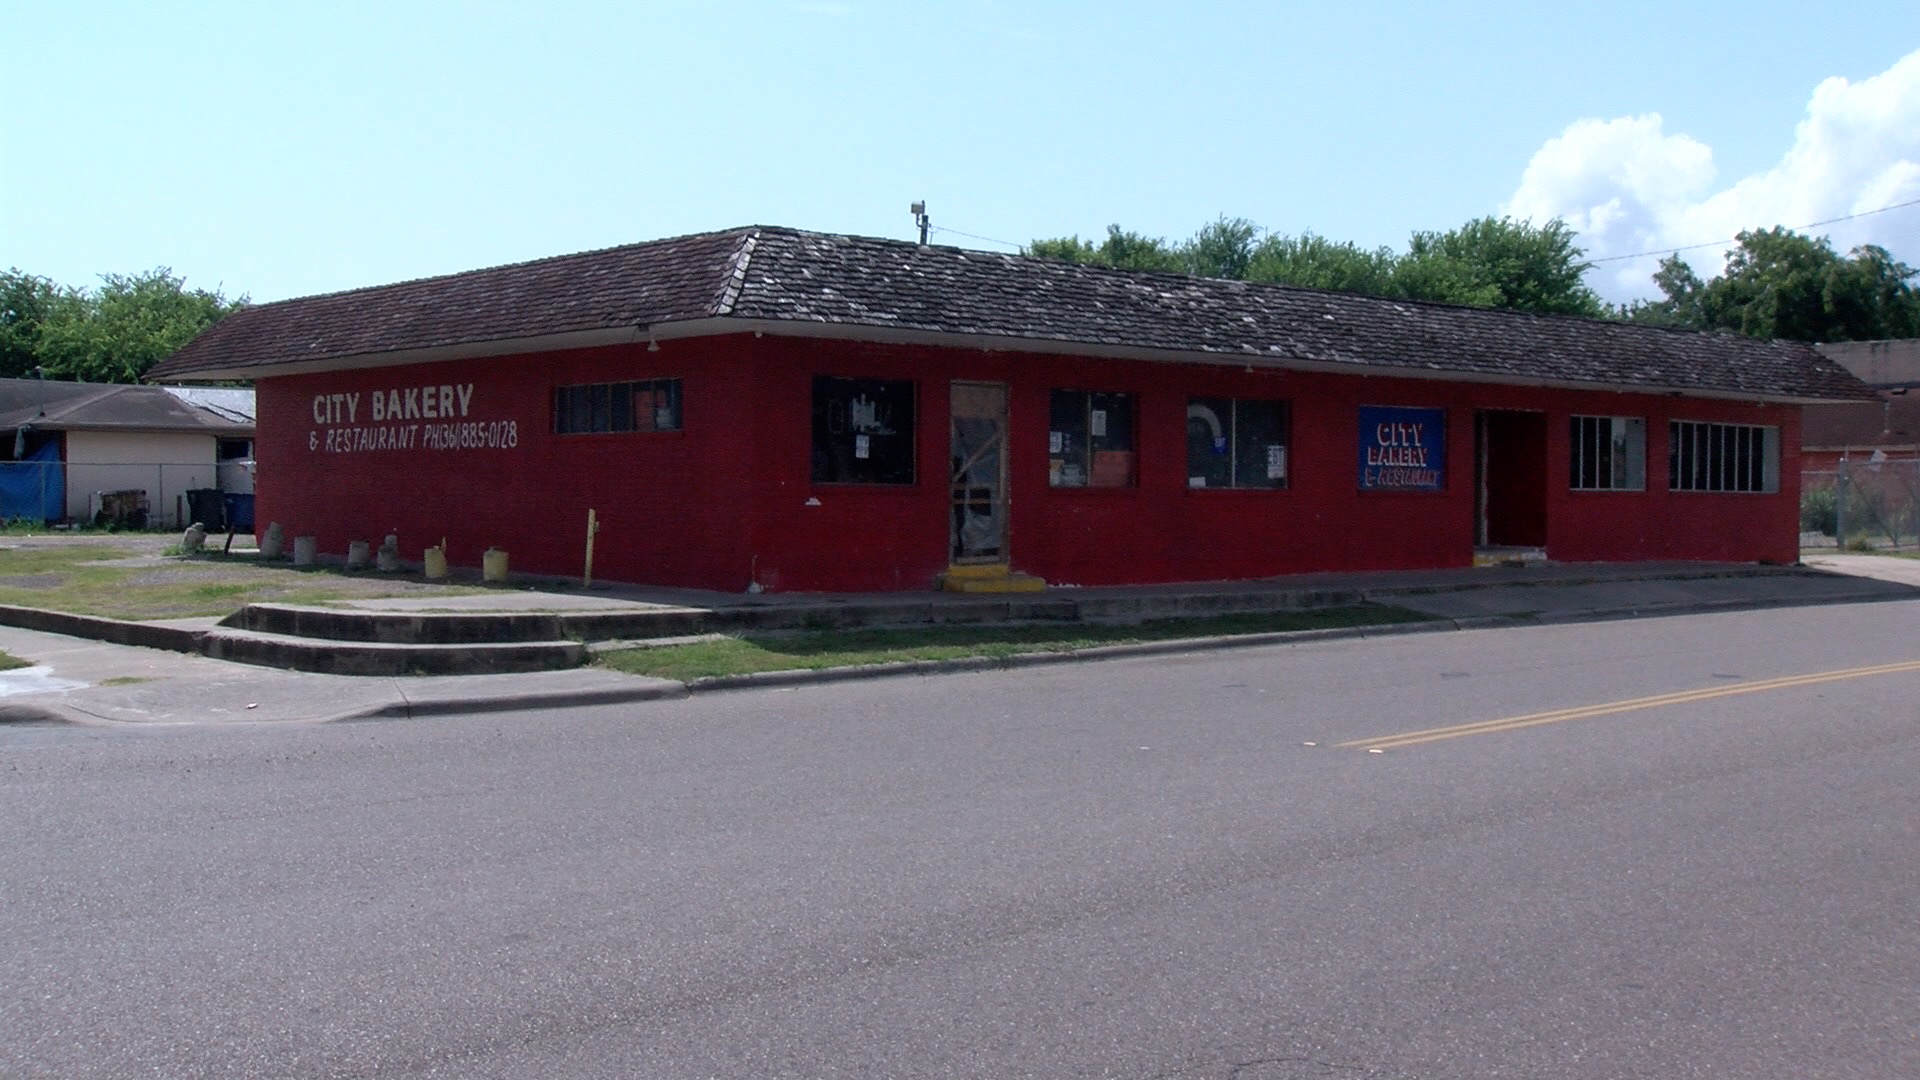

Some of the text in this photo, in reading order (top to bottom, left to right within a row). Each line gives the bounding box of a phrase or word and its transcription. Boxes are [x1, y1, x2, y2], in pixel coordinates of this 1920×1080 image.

[313, 383, 474, 424] CITY BAKERY
[309, 430, 319, 451] &
[325, 425, 418, 452] RESTAURANT
[1377, 422, 1423, 446] CITY
[1367, 446, 1428, 467] BAKERY
